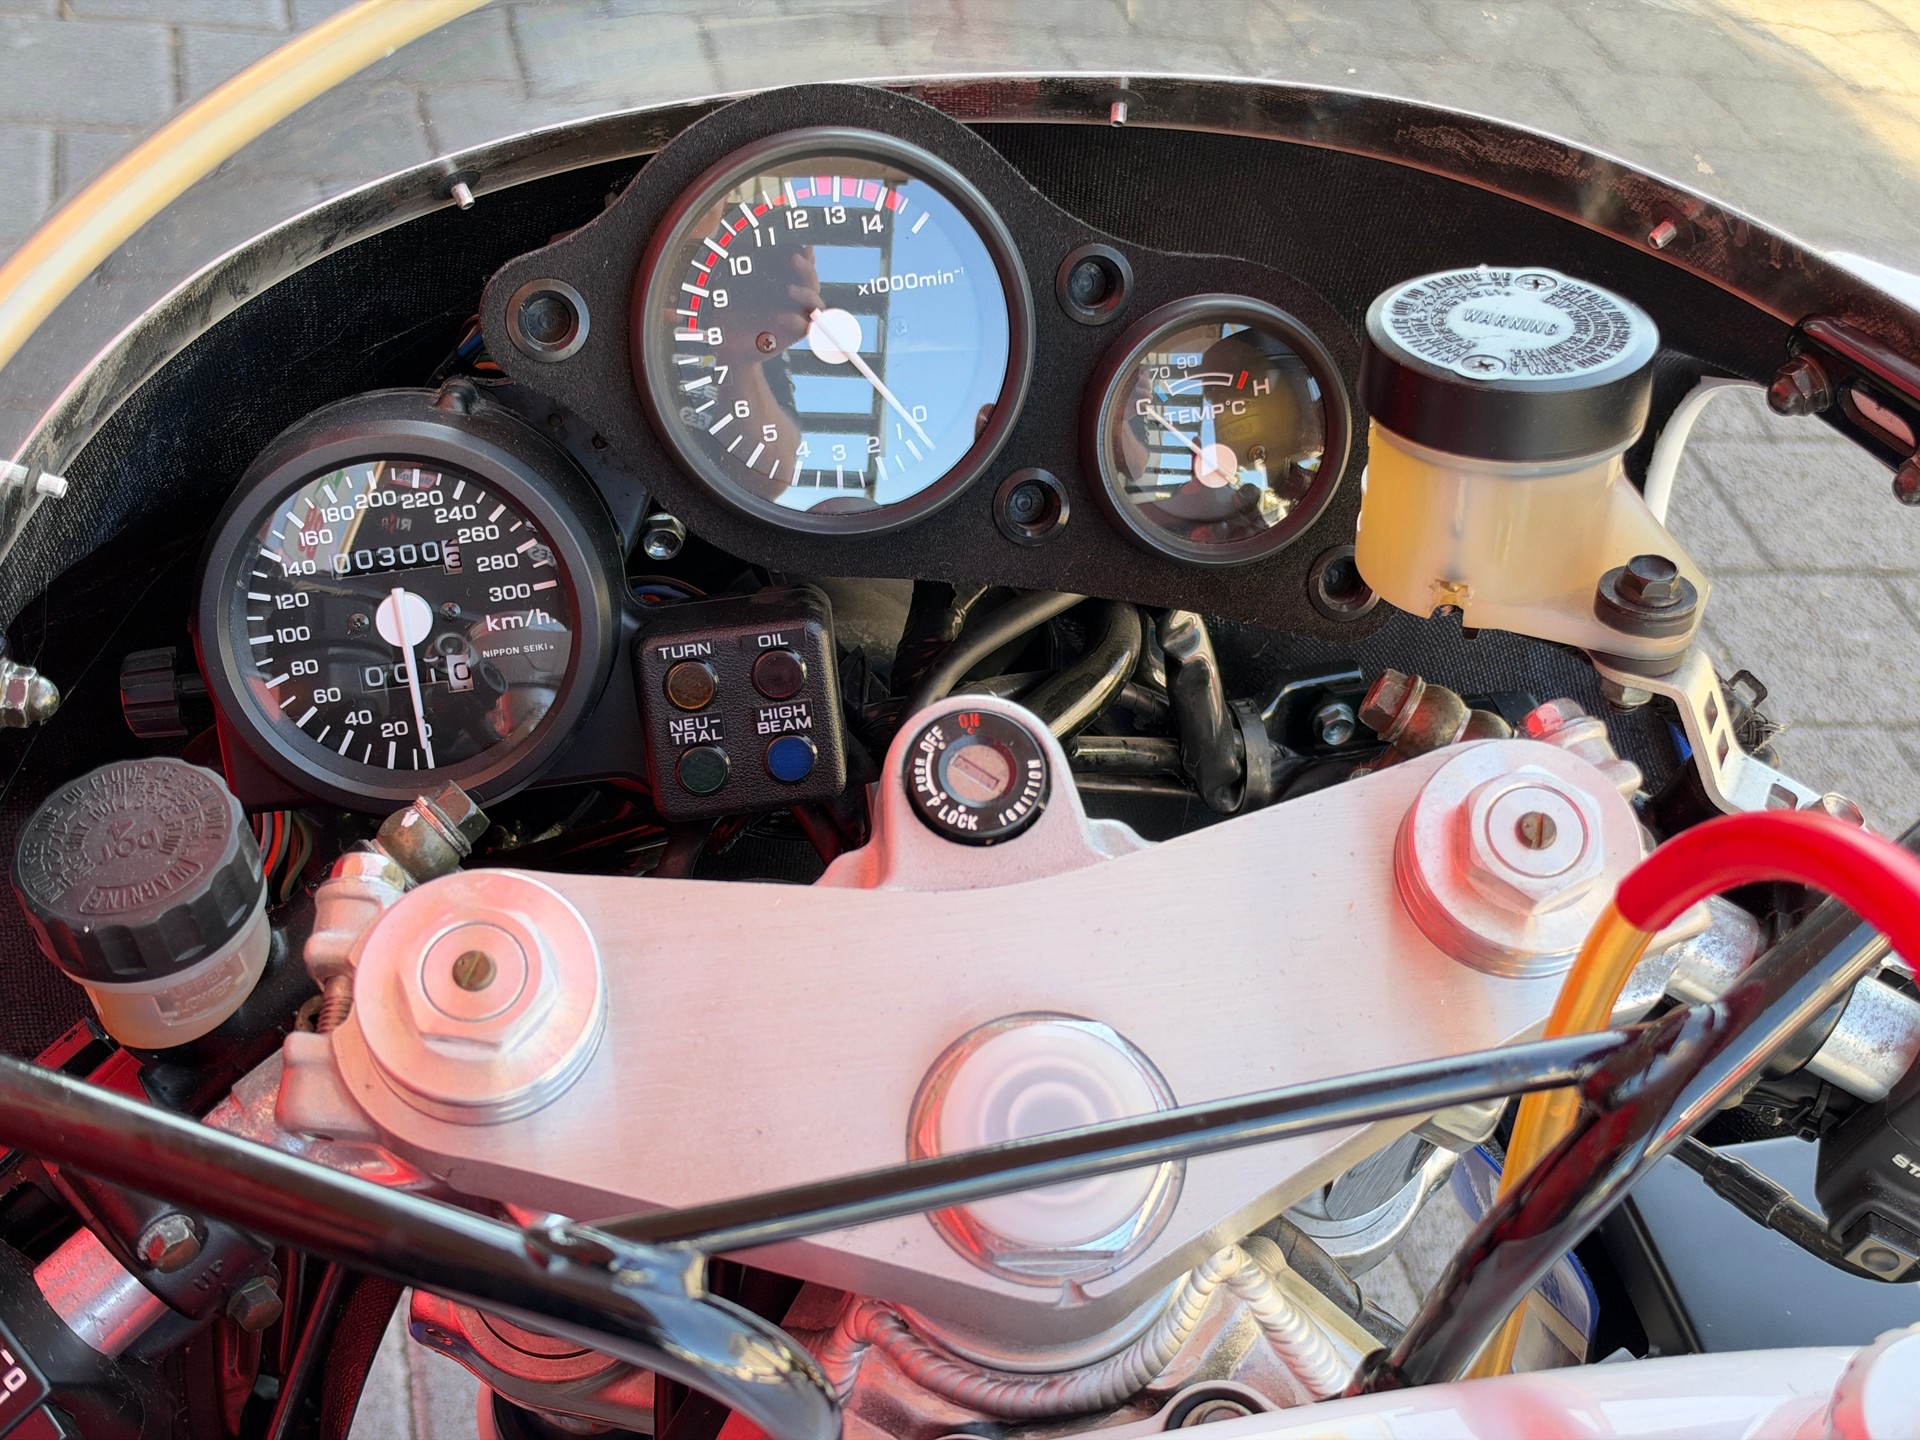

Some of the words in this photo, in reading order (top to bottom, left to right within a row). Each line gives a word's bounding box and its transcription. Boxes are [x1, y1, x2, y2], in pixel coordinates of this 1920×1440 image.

[786, 210, 810, 230] 12
[824, 206, 847, 225] 13
[861, 214, 884, 235] 14
[754, 227, 776, 247] 11
[729, 256, 752, 276] 10
[712, 289, 729, 308] 9
[1463, 308, 1559, 336] WARNING
[707, 327, 723, 346] 8
[1176, 355, 1198, 369] 90
[714, 365, 729, 384] 7
[1150, 367, 1171, 380] 70
[1253, 378, 1271, 396] H
[734, 401, 750, 419] 6
[912, 405, 928, 423] 0
[762, 423, 778, 442] 5
[895, 423, 903, 440] 1
[795, 440, 811, 457] 4
[832, 445, 847, 462] 3
[866, 436, 881, 454] 2
[354, 490, 397, 509] 200
[401, 490, 444, 509] 220
[320, 505, 355, 524] 180
[435, 504, 477, 524] 240
[299, 529, 333, 546] 160
[457, 524, 500, 544] 260
[282, 559, 316, 577] 140
[476, 553, 519, 572] 280
[275, 592, 310, 610] 120
[489, 583, 531, 602] 300
[276, 625, 311, 644] 100
[758, 633, 789, 647] OIL
[482, 646, 520, 658] NIPPON
[658, 642, 712, 660] TURN
[291, 659, 319, 677] 80
[313, 687, 341, 704] 60
[344, 709, 373, 726] 40
[759, 704, 807, 721] HIGH
[958, 713, 980, 729] ON
[381, 721, 409, 737] 20
[669, 717, 721, 733] NEU-
[757, 716, 812, 735] BEAM
[671, 728, 723, 745] TRAL
[919, 725, 944, 753] OFF
[914, 757, 929, 793] PUSH
[926, 796, 941, 807] P
[999, 759, 1042, 826] IGNITION
[937, 804, 979, 831] LOCK
[84, 863, 194, 909] WARNING
[1892, 1153, 1920, 1178] ST
